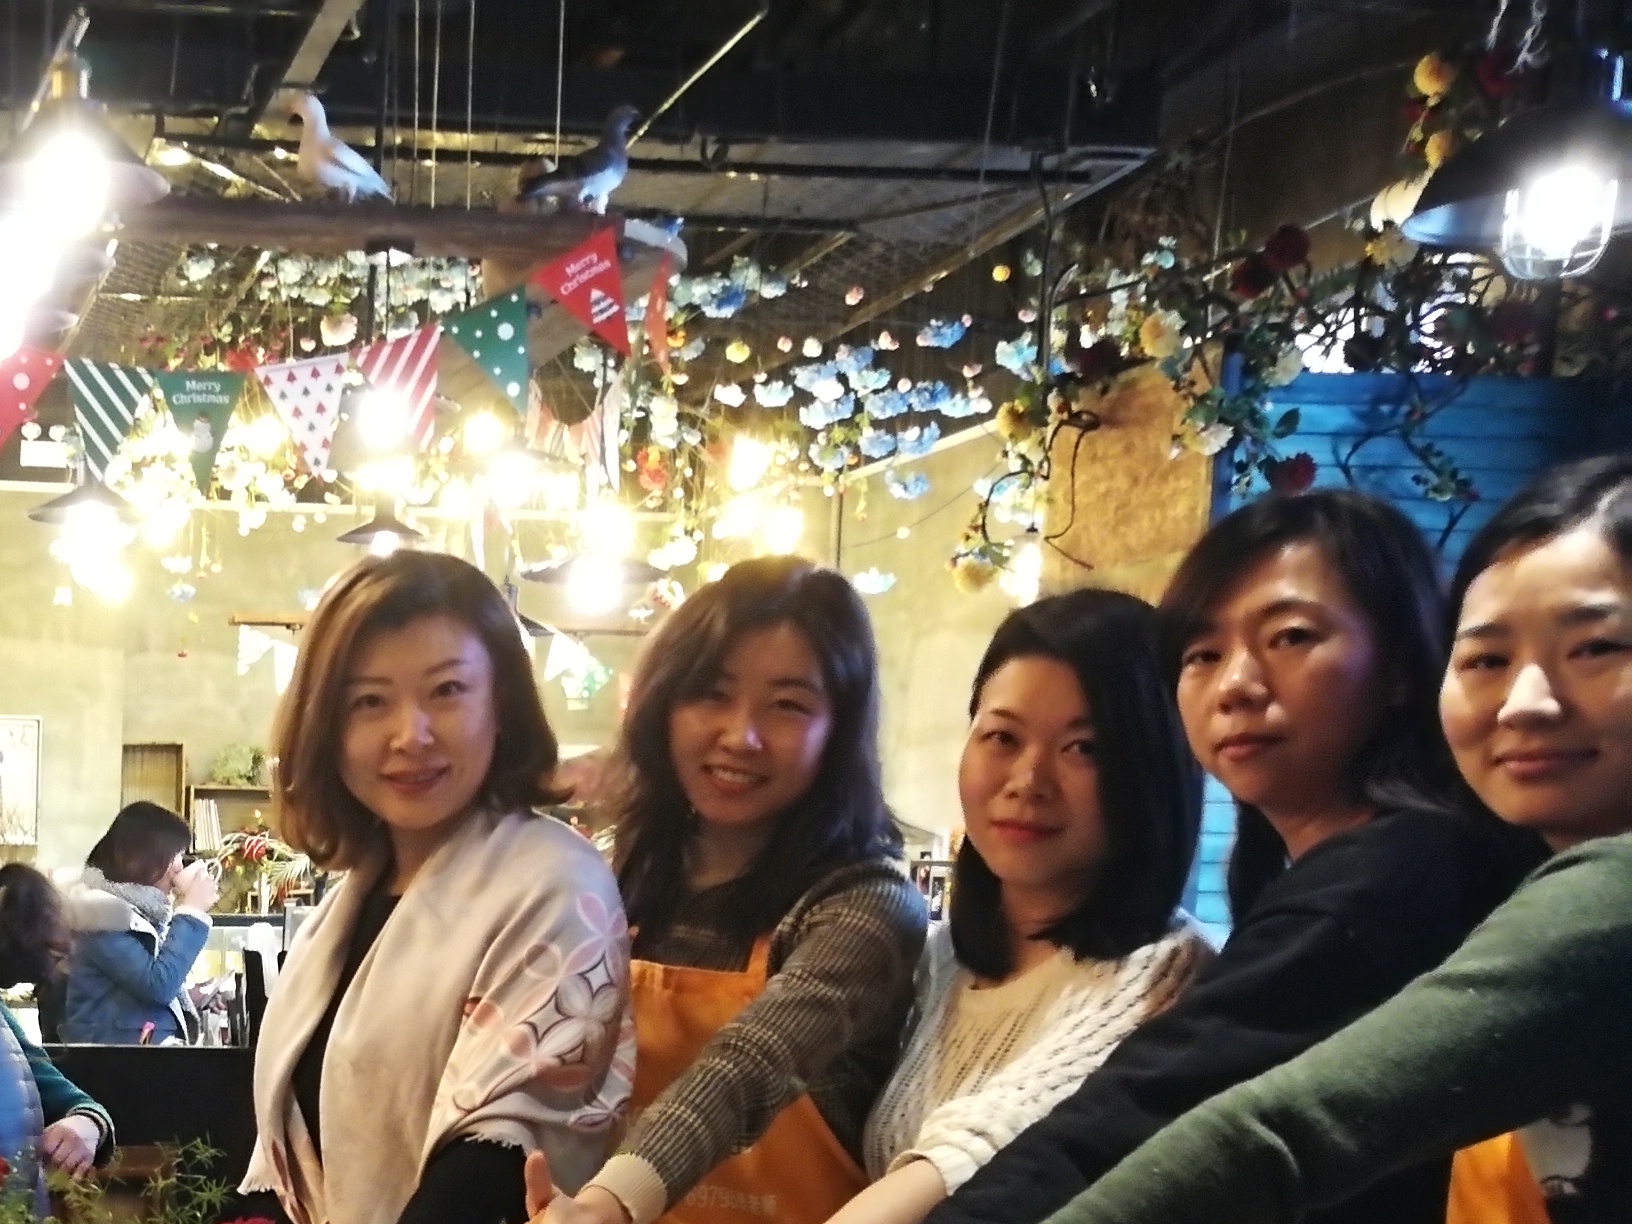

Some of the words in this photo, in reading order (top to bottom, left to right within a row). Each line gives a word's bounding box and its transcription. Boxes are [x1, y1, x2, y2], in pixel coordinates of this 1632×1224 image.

[565, 252, 598, 277] Merry
[560, 259, 612, 295] Christmas
[185, 379, 221, 393] Merry
[172, 392, 230, 406] Christmas
